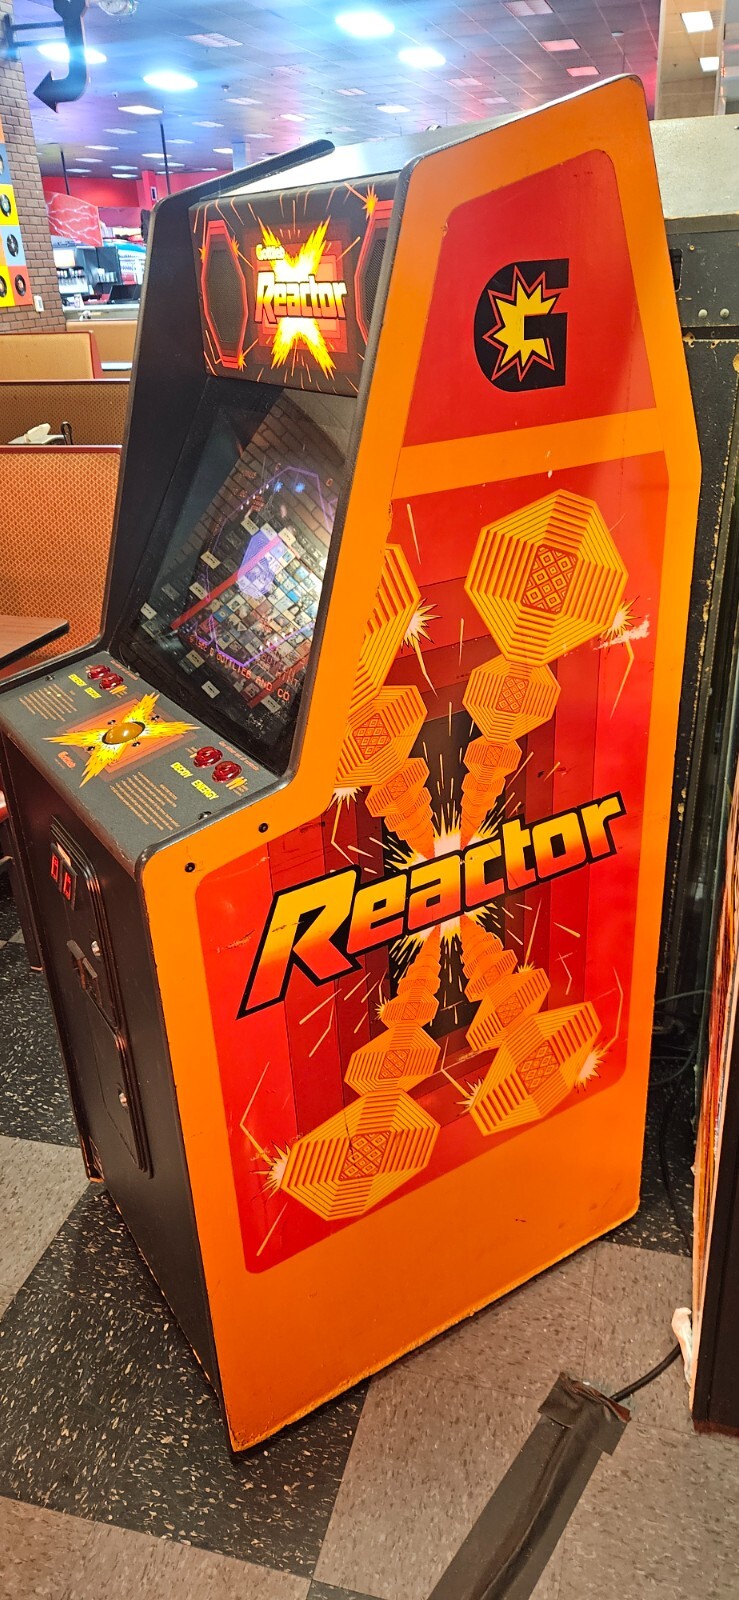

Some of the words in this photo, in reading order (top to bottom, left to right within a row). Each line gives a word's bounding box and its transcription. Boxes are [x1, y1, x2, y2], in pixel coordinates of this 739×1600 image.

[255, 270, 347, 323] Reactor
[170, 762, 194, 778] DECOY
[191, 779, 219, 800] ENERGY
[237, 791, 627, 1019] Reactor
